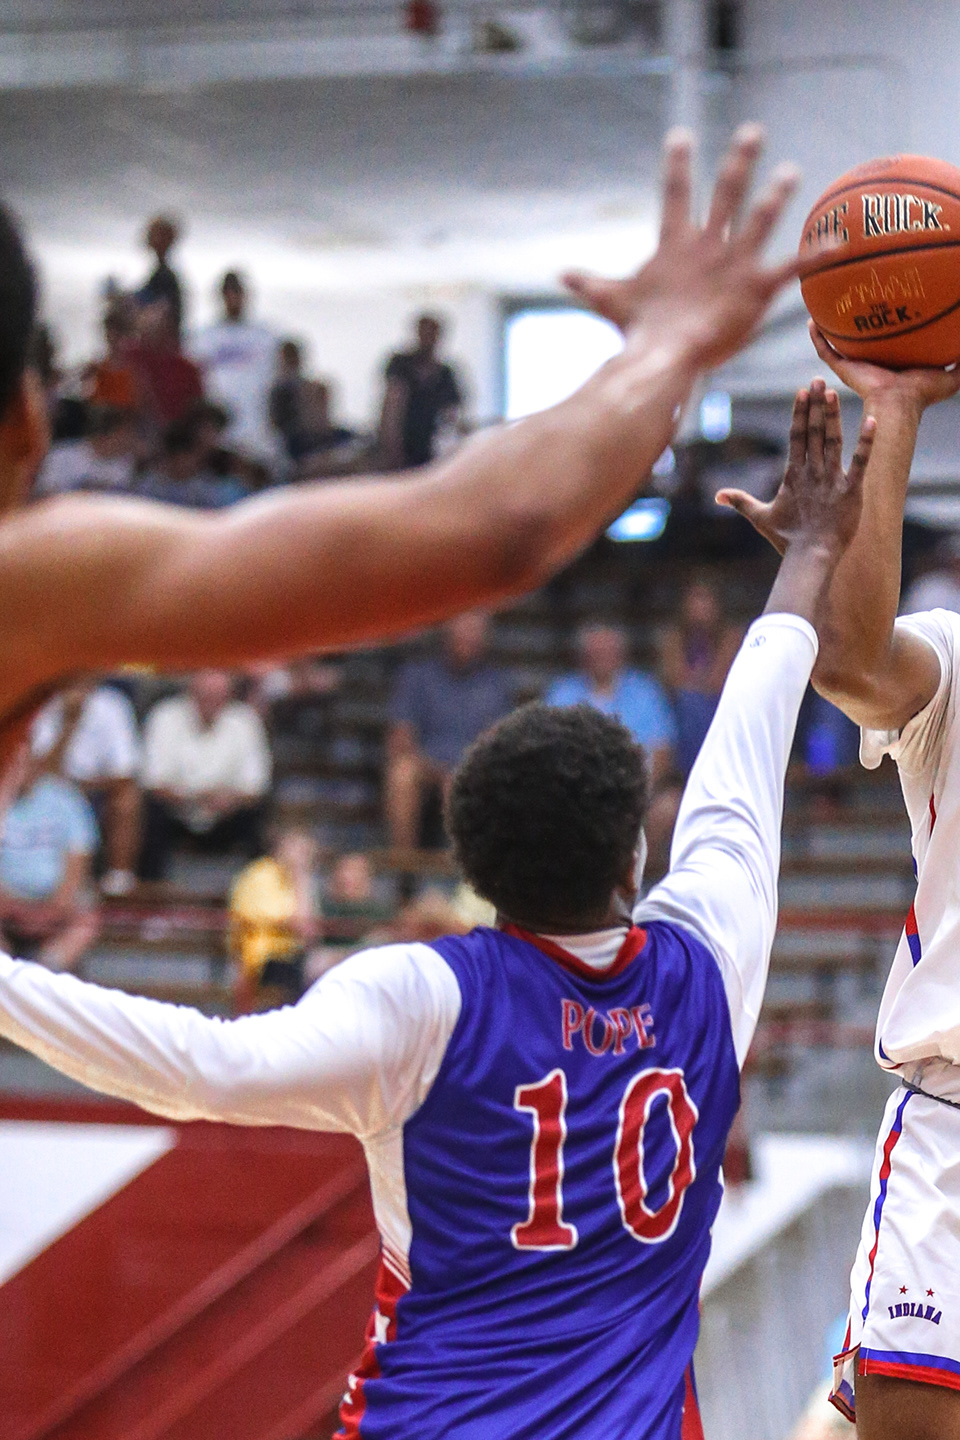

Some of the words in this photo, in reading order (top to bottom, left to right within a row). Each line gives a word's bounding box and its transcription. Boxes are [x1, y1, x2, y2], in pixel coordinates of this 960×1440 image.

[804, 200, 850, 246] THE
[561, 998, 656, 1056] POPE
[510, 1067, 699, 1251] 10
[887, 1302, 942, 1325] INDIANA
